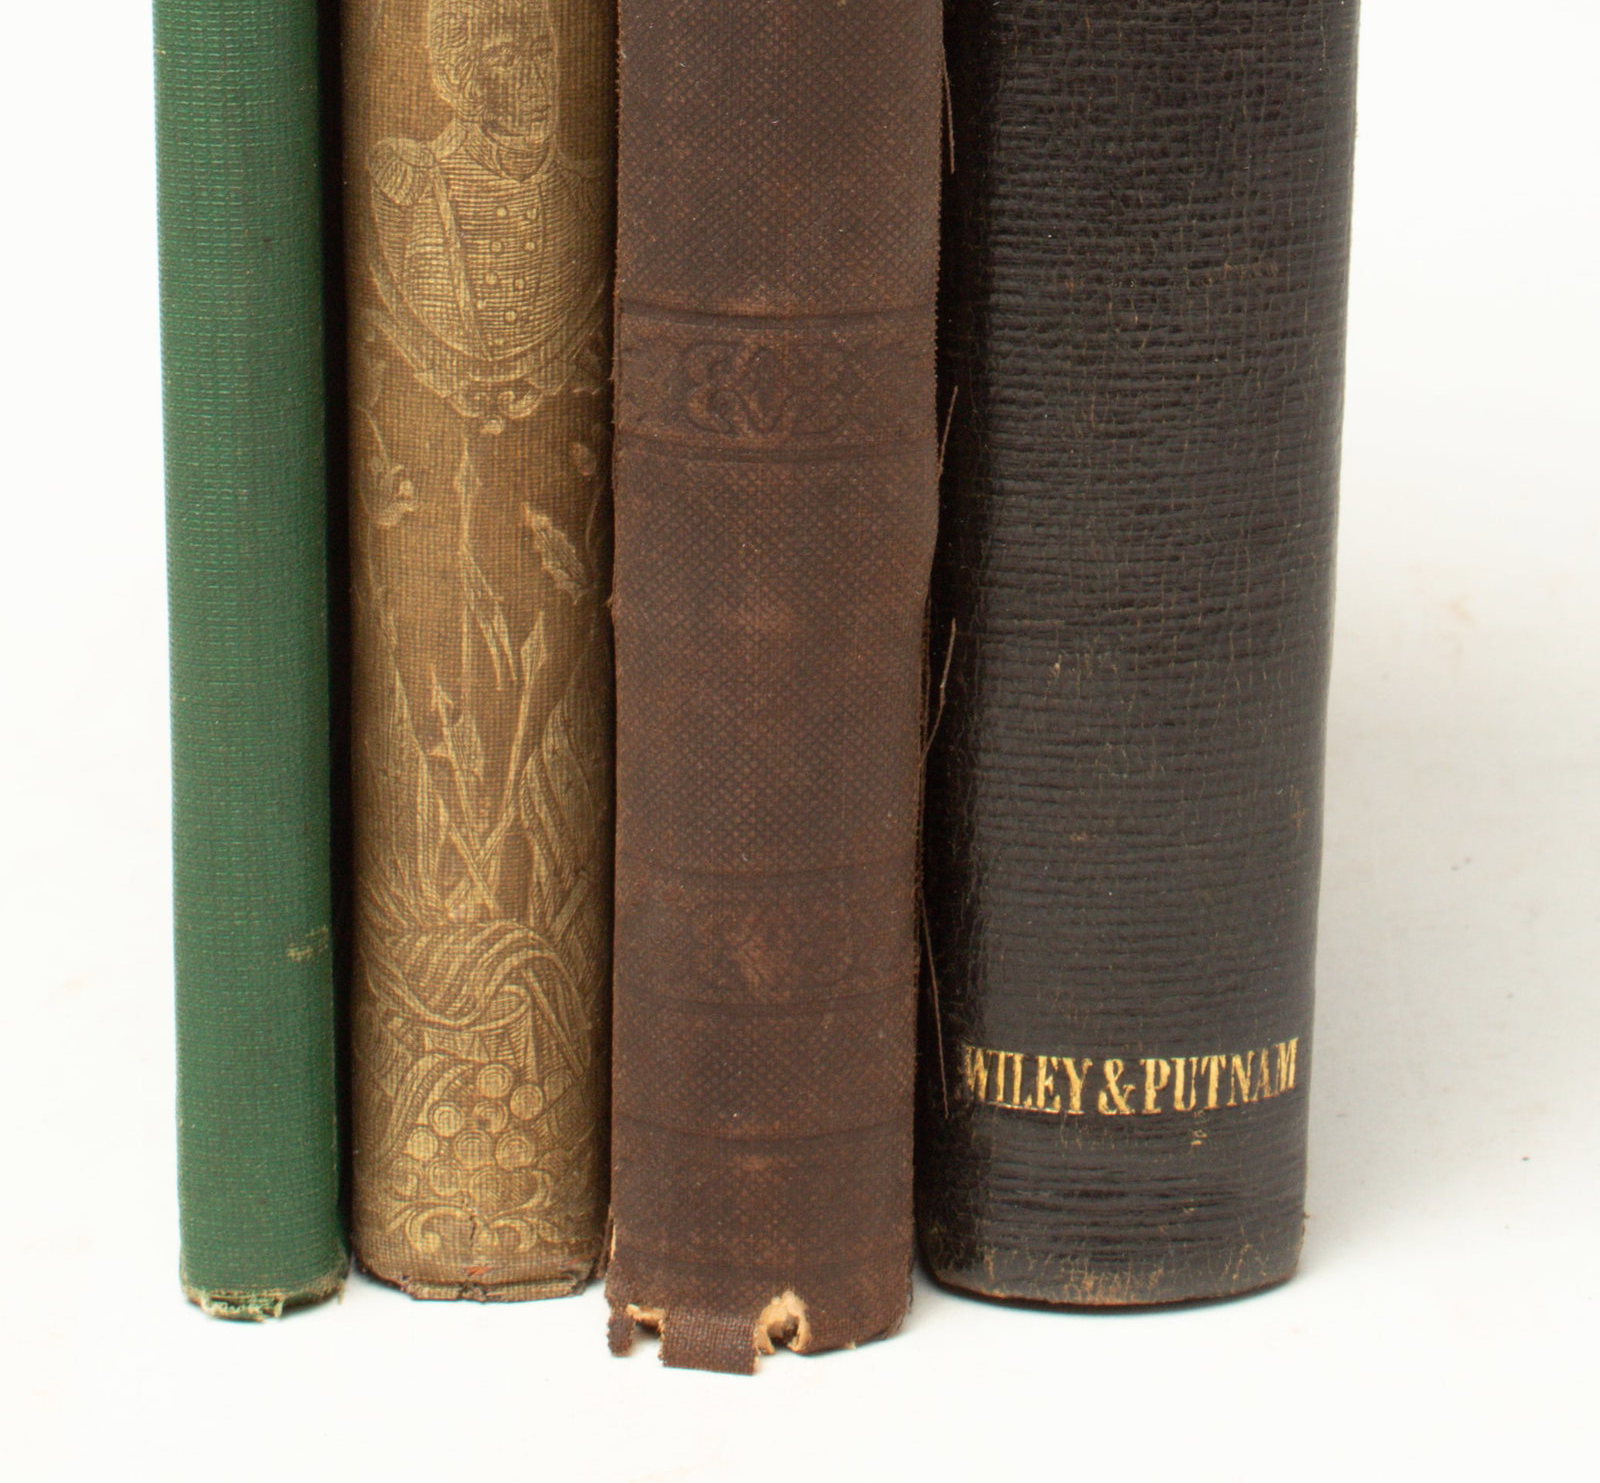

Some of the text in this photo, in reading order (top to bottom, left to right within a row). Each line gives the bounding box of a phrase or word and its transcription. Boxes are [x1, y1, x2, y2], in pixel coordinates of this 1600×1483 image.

[962, 1037, 1299, 1116] WILEY & PUTNAM
